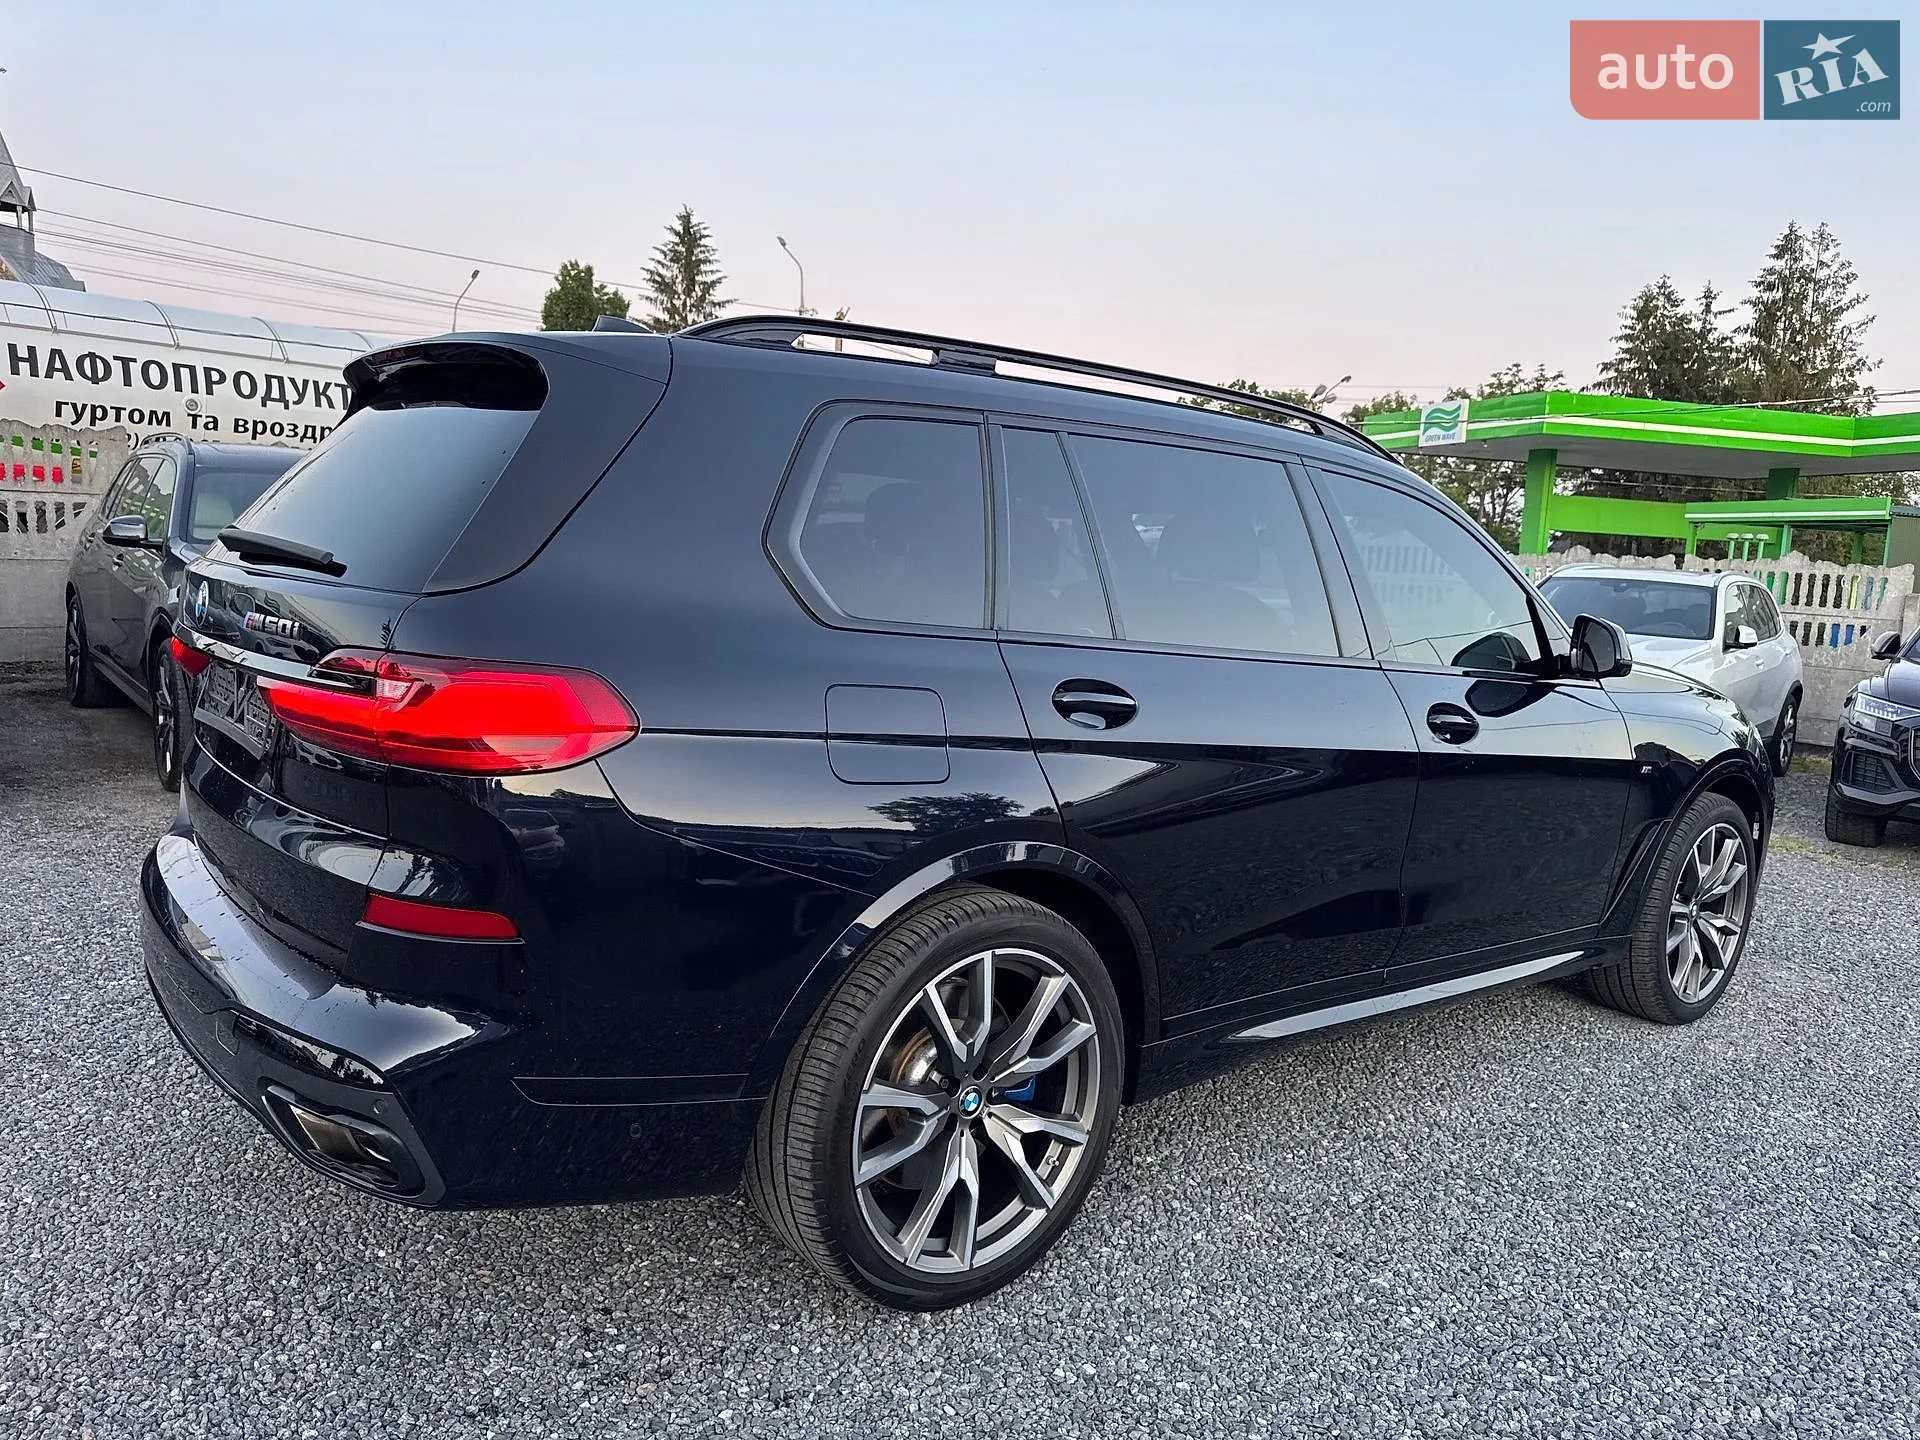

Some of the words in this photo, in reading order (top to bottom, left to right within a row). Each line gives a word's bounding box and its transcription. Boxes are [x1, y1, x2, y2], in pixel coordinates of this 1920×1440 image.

[7, 342, 351, 411] НАФТОПРОДУКТ
[55, 400, 172, 427] гуртом
[187, 412, 219, 432] та
[233, 416, 333, 444] вроздр
